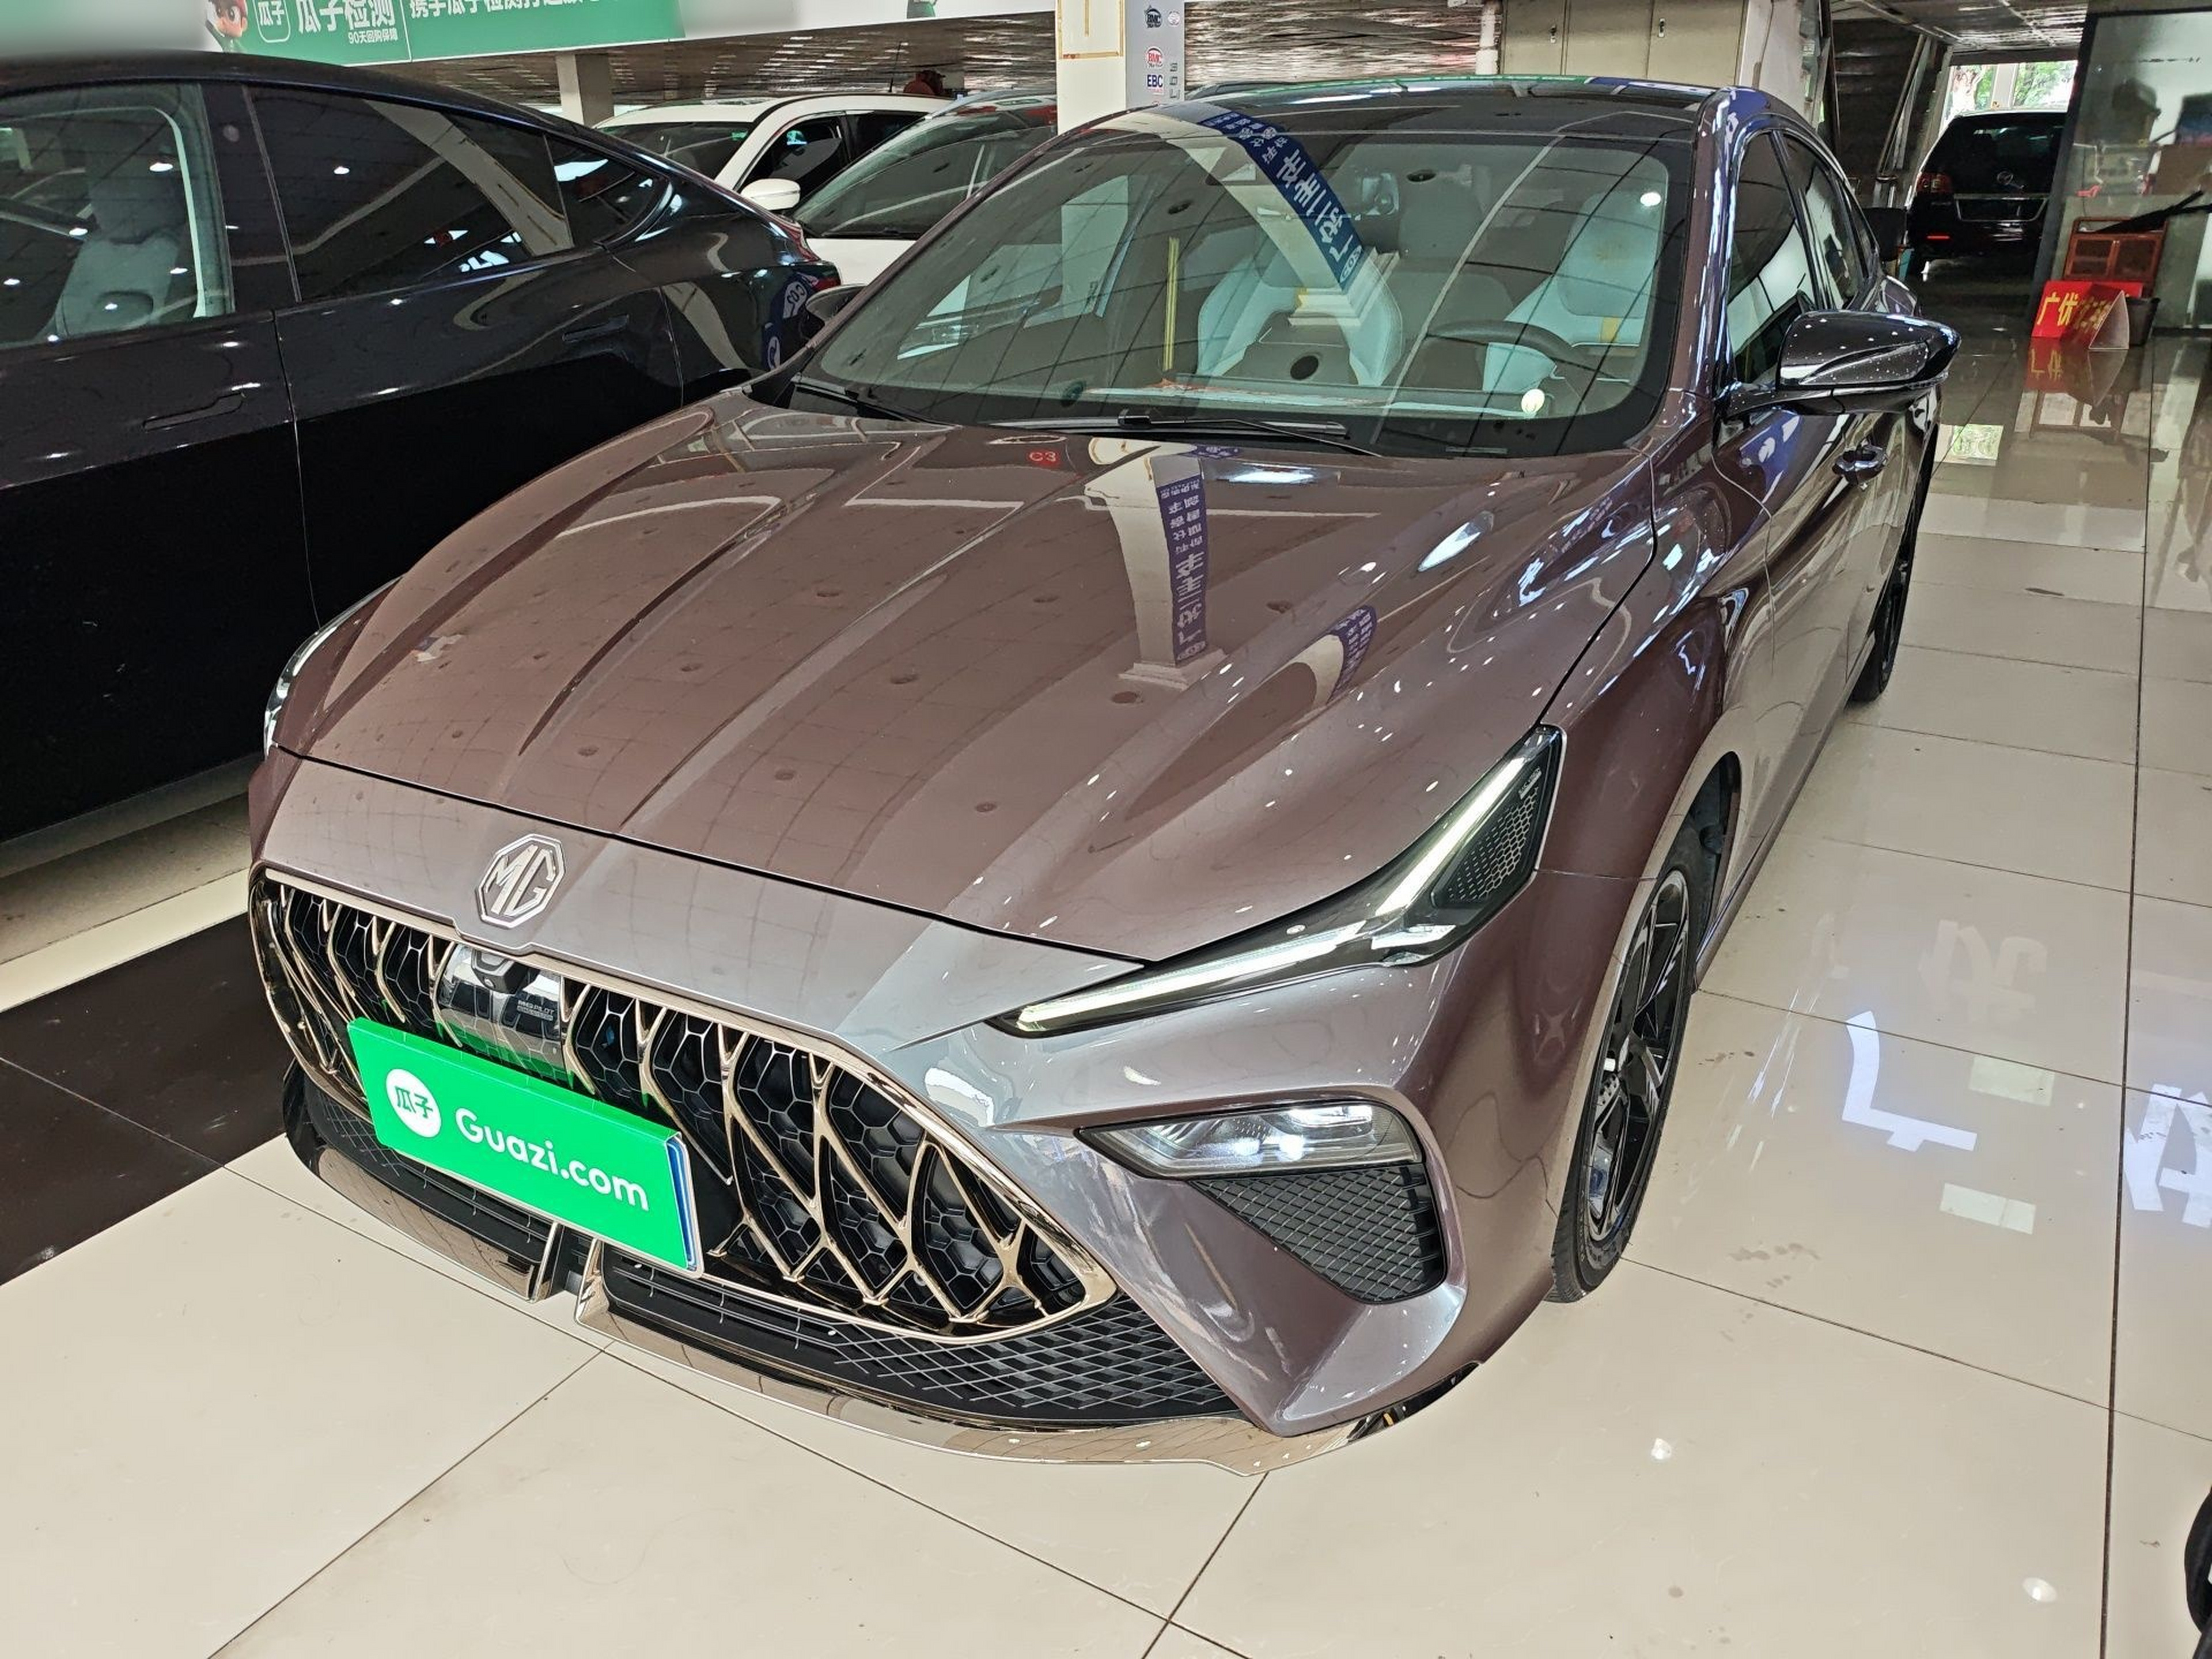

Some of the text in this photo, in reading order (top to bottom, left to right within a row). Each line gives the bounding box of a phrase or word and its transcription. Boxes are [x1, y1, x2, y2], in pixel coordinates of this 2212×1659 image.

[258, 1, 285, 26] 瓜子
[296, 0, 396, 33] 瓜子检测
[1147, 75, 1163, 87] EBC
[486, 844, 556, 917] MG
[395, 1086, 433, 1119] 瓜子
[455, 1108, 649, 1211] Guazi.com
